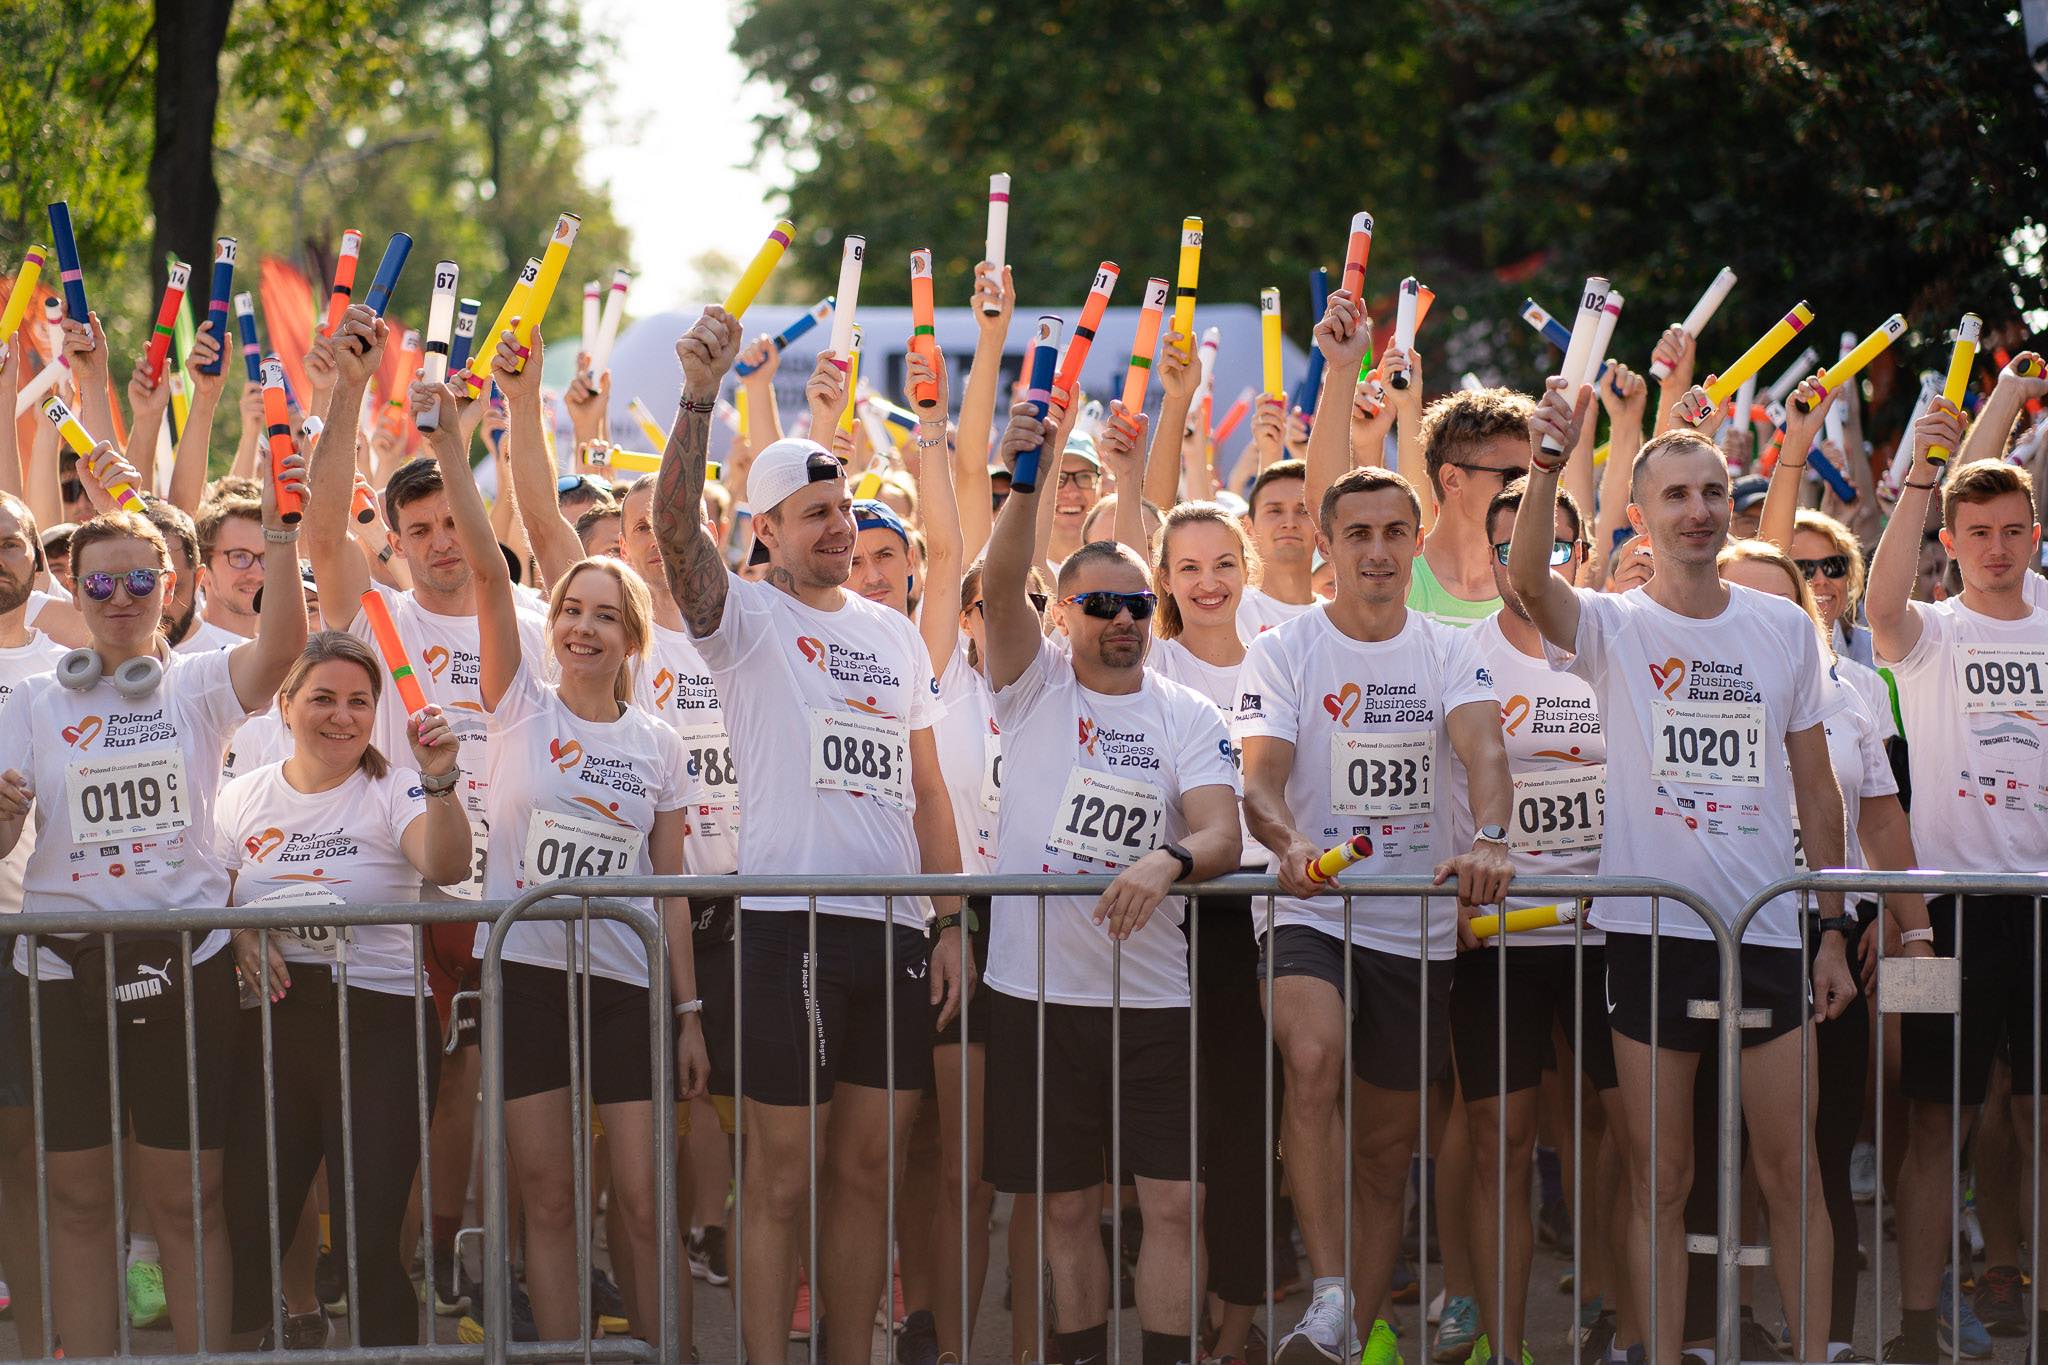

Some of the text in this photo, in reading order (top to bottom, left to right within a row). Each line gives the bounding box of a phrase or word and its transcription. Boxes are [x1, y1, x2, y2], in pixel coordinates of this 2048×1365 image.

[172, 271, 186, 286] 14
[436, 271, 456, 290] 67
[1585, 292, 1605, 312] 02
[456, 317, 474, 333] 62
[829, 644, 878, 663] Poand
[1691, 660, 1743, 676] Poland
[451, 673, 478, 685] Run
[829, 668, 900, 688] Run 2024
[1690, 674, 1754, 691] Business
[1965, 661, 2044, 695] 0991
[677, 686, 718, 698] Busin
[1366, 683, 1417, 696] Poland
[1688, 688, 1762, 703] Run 2024
[676, 698, 722, 710] Run 2
[1365, 697, 1427, 710] Business
[1535, 697, 1591, 709] Poland
[108, 709, 163, 725] Poland
[1363, 710, 1435, 723] Run 2024
[1534, 709, 1600, 722] Business
[1676, 710, 1696, 718] Poland
[1721, 712, 1734, 720] Run
[1734, 712, 1751, 720] 2024
[106, 722, 173, 737] Business
[1096, 727, 1145, 743] Poland
[1532, 722, 1601, 734] Run 202
[103, 737, 135, 748] Run
[1747, 729, 1758, 745] U
[896, 745, 903, 762] R
[1099, 740, 1155, 756] usiness
[1663, 725, 1740, 767] 1020
[137, 761, 151, 769] Run
[823, 734, 892, 780] 0883
[1120, 755, 1160, 771] 2024
[1422, 755, 1430, 772] G
[1748, 751, 1757, 769] 1
[584, 762, 643, 784] Bsiness
[897, 767, 902, 785] 1
[1348, 758, 1417, 797] 0333
[166, 773, 177, 791] C
[611, 779, 647, 799] 2024
[1423, 777, 1429, 794] 1
[1523, 775, 1597, 788] Poland Business Run 2024
[81, 777, 161, 823] 0119
[1135, 791, 1146, 799] Run
[1595, 788, 1605, 804] G
[170, 796, 180, 813] 1
[1518, 791, 1592, 834] 0331
[1065, 794, 1147, 848] 1202
[284, 837, 352, 854] Business
[1148, 833, 1157, 851] 1
[70, 851, 85, 860] GLS
[103, 846, 117, 856] blik
[277, 846, 359, 863] Run 2024
[537, 838, 614, 879] 0167
[617, 852, 628, 870] D
[819, 1038, 827, 1067] Regrets
